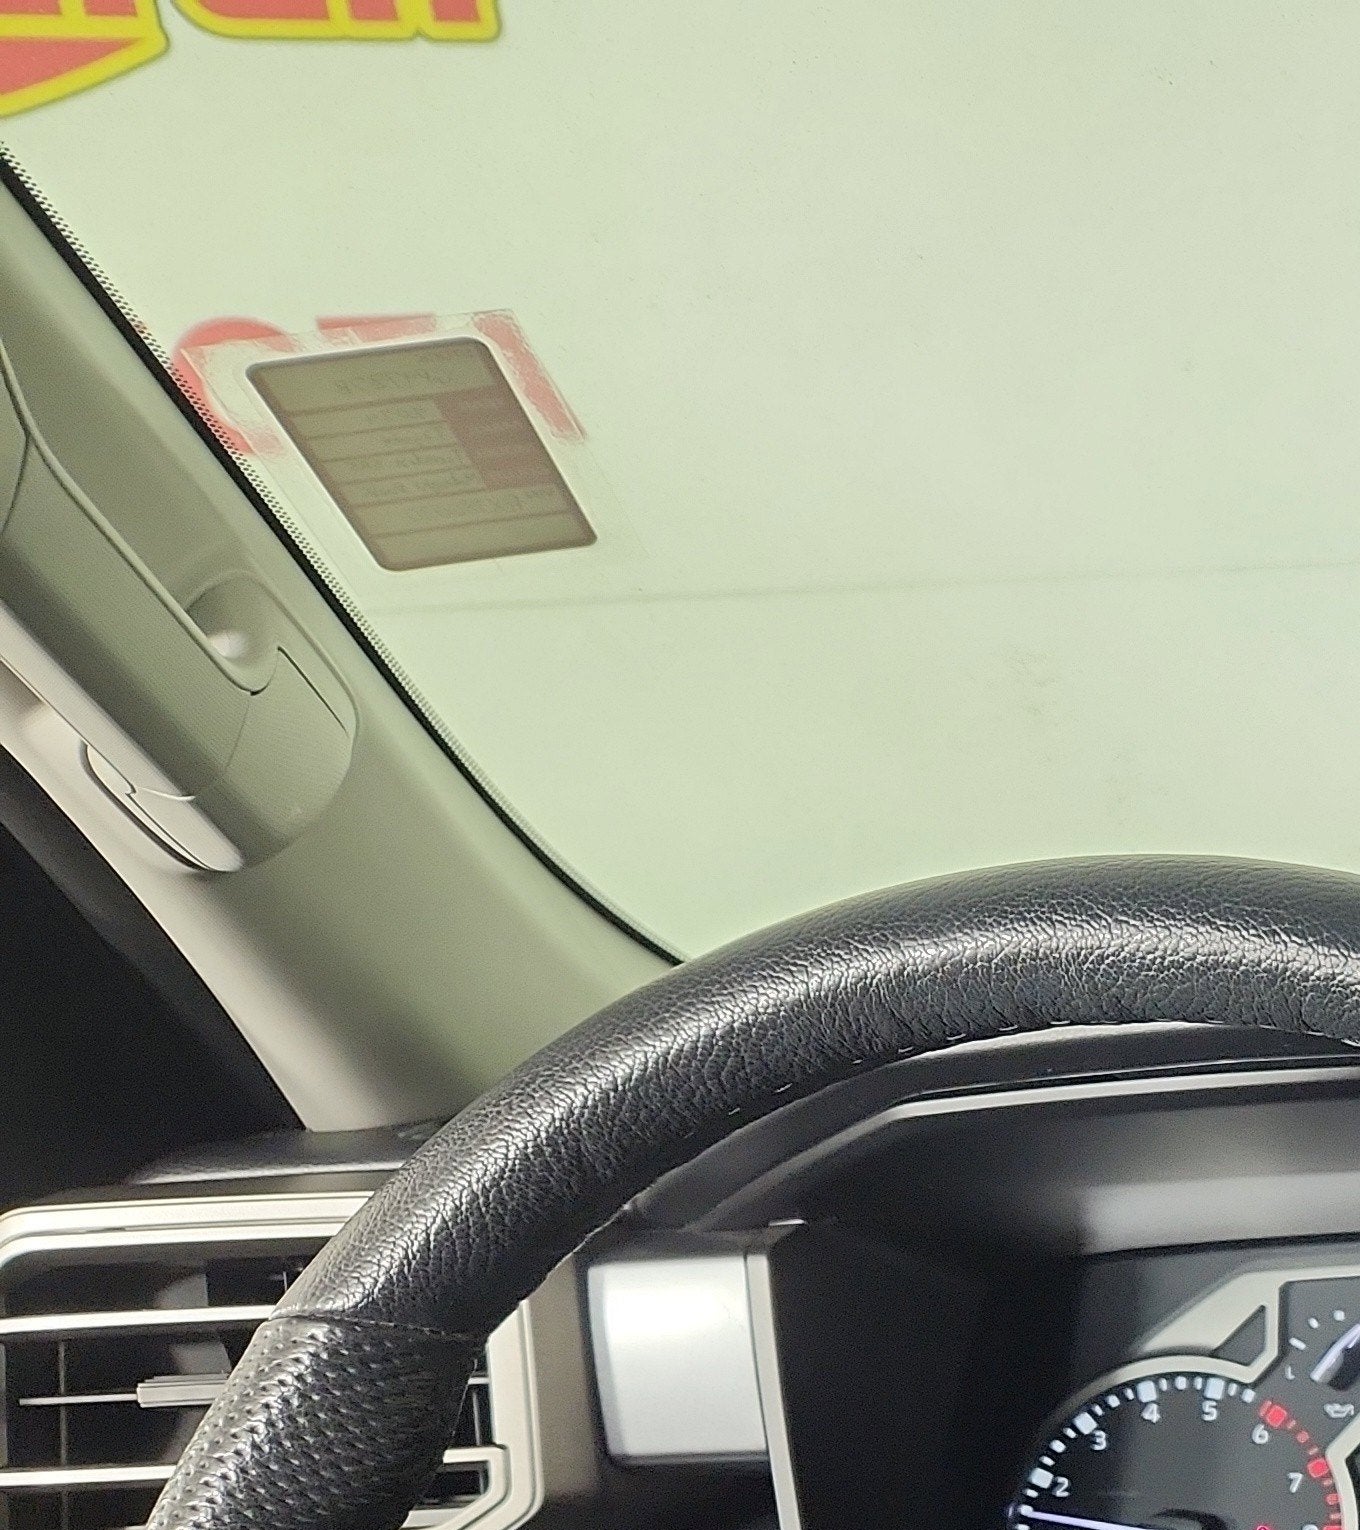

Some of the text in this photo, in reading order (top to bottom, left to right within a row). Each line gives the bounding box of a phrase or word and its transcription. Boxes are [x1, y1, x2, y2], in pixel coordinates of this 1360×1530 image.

[1141, 1402, 1161, 1424] 4
[1201, 1400, 1219, 1421] 5
[1091, 1429, 1107, 1451] 3
[1251, 1423, 1270, 1445] 6
[1054, 1476, 1071, 1498] 2
[1287, 1472, 1304, 1494] 7
